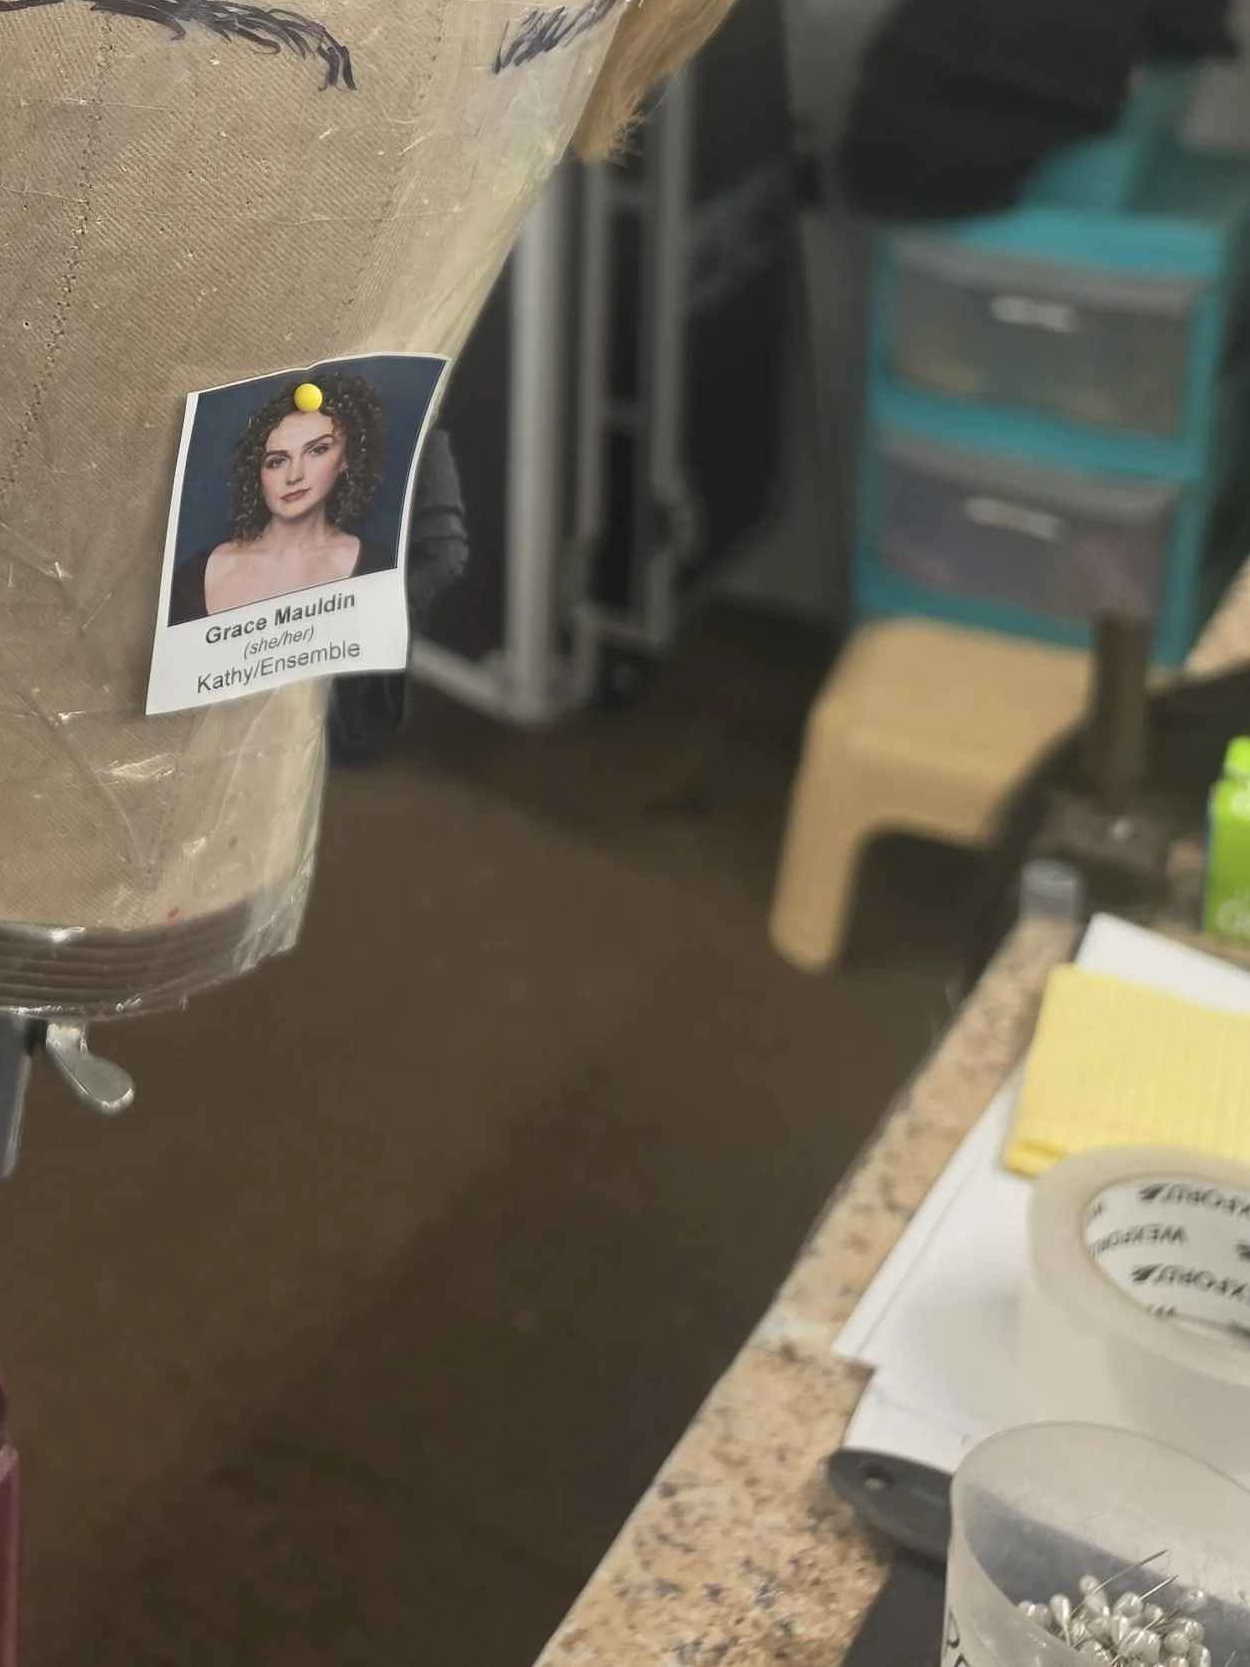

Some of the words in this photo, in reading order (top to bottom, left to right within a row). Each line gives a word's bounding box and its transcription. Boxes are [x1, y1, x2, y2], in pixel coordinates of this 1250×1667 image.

[205, 617, 267, 644] Grace
[274, 593, 355, 626] Mauldin
[243, 624, 314, 660] (she/her)
[197, 639, 360, 694] Kathy/Ensemble
